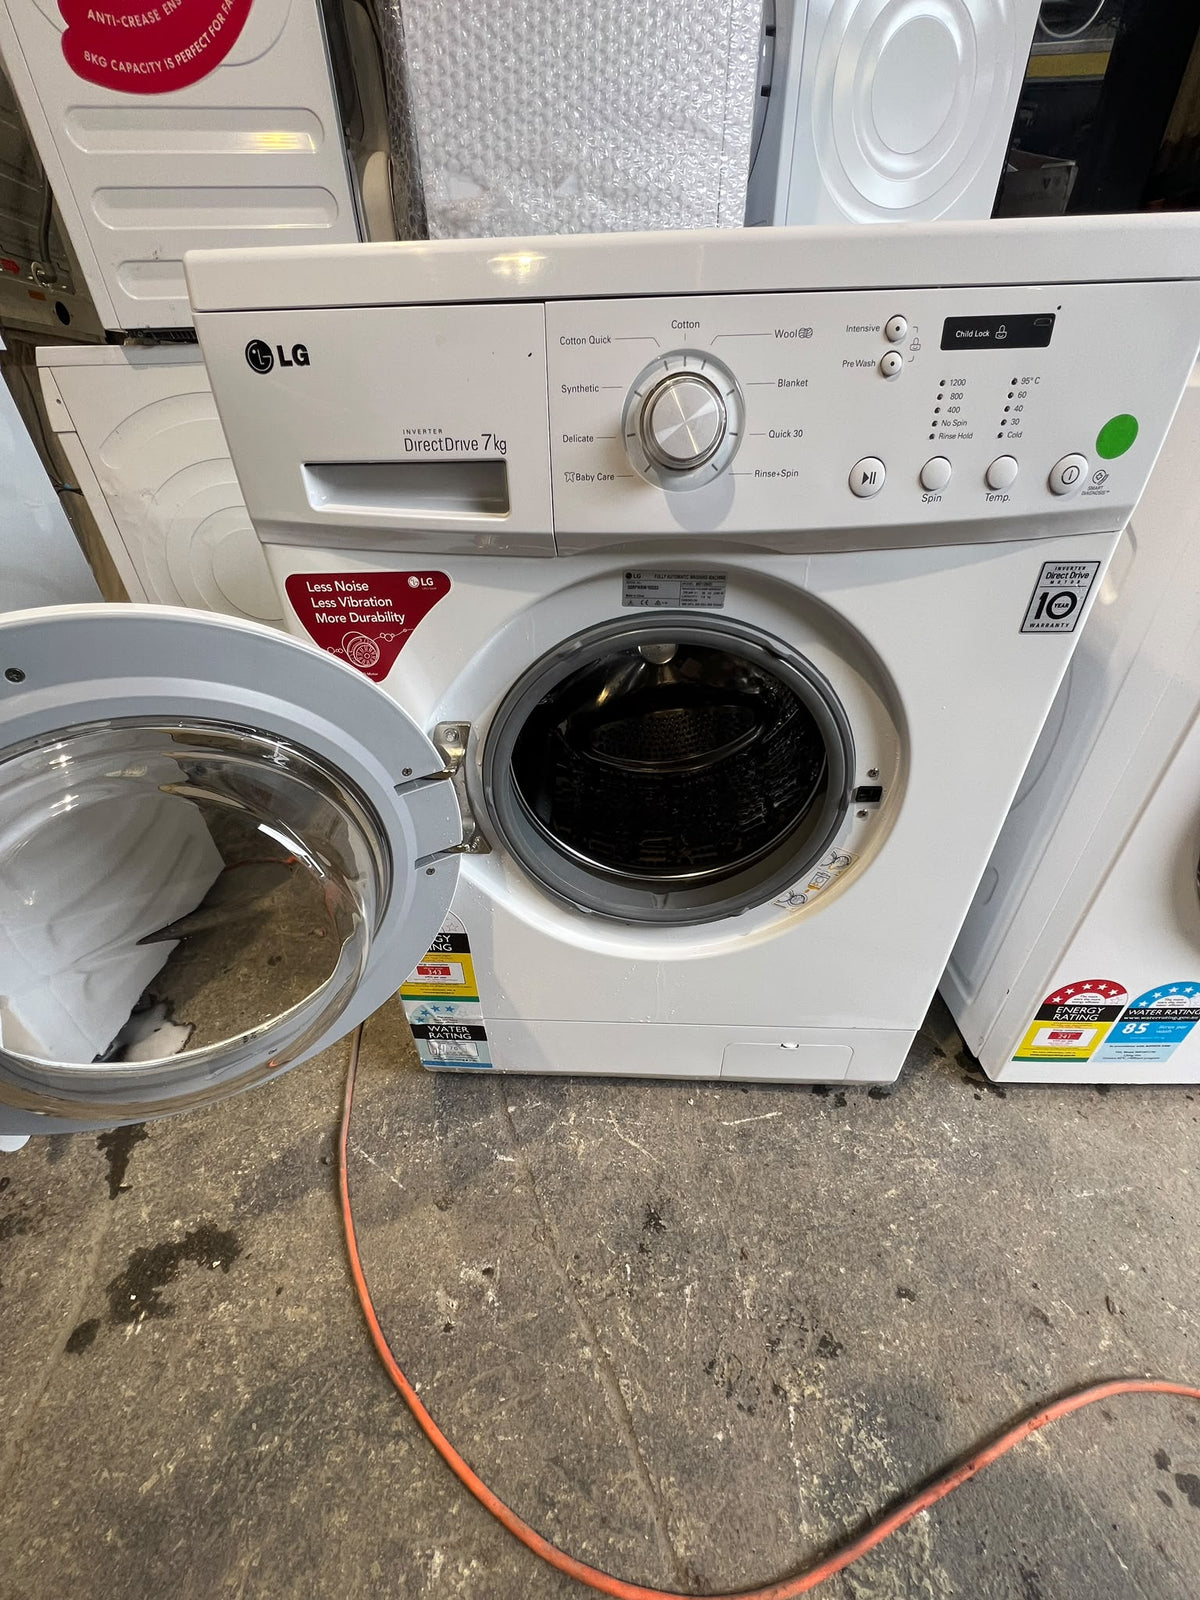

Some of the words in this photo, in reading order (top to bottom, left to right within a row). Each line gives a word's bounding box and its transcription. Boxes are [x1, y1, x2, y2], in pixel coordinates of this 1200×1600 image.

[87, 9, 162, 28] ANTI-CREASE
[84, 50, 107, 68] 8KG
[111, 59, 163, 75] CAPACITY
[164, 57, 175, 70] IS
[174, 32, 212, 67] PERFECT
[208, 12, 227, 38] FOR
[671, 320, 700, 329] Cotton
[845, 324, 881, 333] Intensive
[774, 329, 798, 339] Wool
[955, 330, 974, 338] Child
[975, 329, 990, 338] Lock
[559, 336, 587, 346] Cotton
[588, 335, 612, 346] Quick
[277, 343, 311, 367] LG
[841, 359, 855, 368] Pre
[855, 359, 876, 368] Wash
[777, 378, 809, 388] Blanket
[949, 378, 967, 387] 1200
[561, 384, 600, 395] Synthetic
[949, 392, 964, 400] 800
[1017, 391, 1027, 399] 60
[947, 406, 961, 414] 400
[1013, 405, 1024, 413] 40
[940, 419, 951, 427] No
[952, 419, 968, 429] Spin
[1010, 418, 1020, 426] 30
[562, 434, 594, 443] Delicate
[768, 429, 791, 439] Quick
[792, 429, 804, 438] 30
[938, 432, 958, 440] Rinse
[959, 431, 974, 440] Hold
[1007, 431, 1023, 439] Cold
[575, 472, 595, 482] Baby
[596, 472, 615, 481] Care
[754, 469, 799, 479] Rinse+Spin
[921, 493, 942, 503] Spin
[985, 492, 1011, 503] Temp.
[1045, 571, 1069, 580] Direct
[1069, 571, 1090, 579] Drive
[306, 581, 333, 592] Less
[334, 580, 369, 592] Noise
[310, 597, 337, 608] Less
[338, 596, 393, 607] Vibration
[1034, 591, 1078, 620] 10
[315, 612, 347, 623] More
[349, 611, 405, 625] Durability
[1056, 1006, 1106, 1014] ENERGY
[427, 1025, 470, 1033] WATER
[1122, 1023, 1150, 1034] 85
[428, 1032, 472, 1040] RATING
